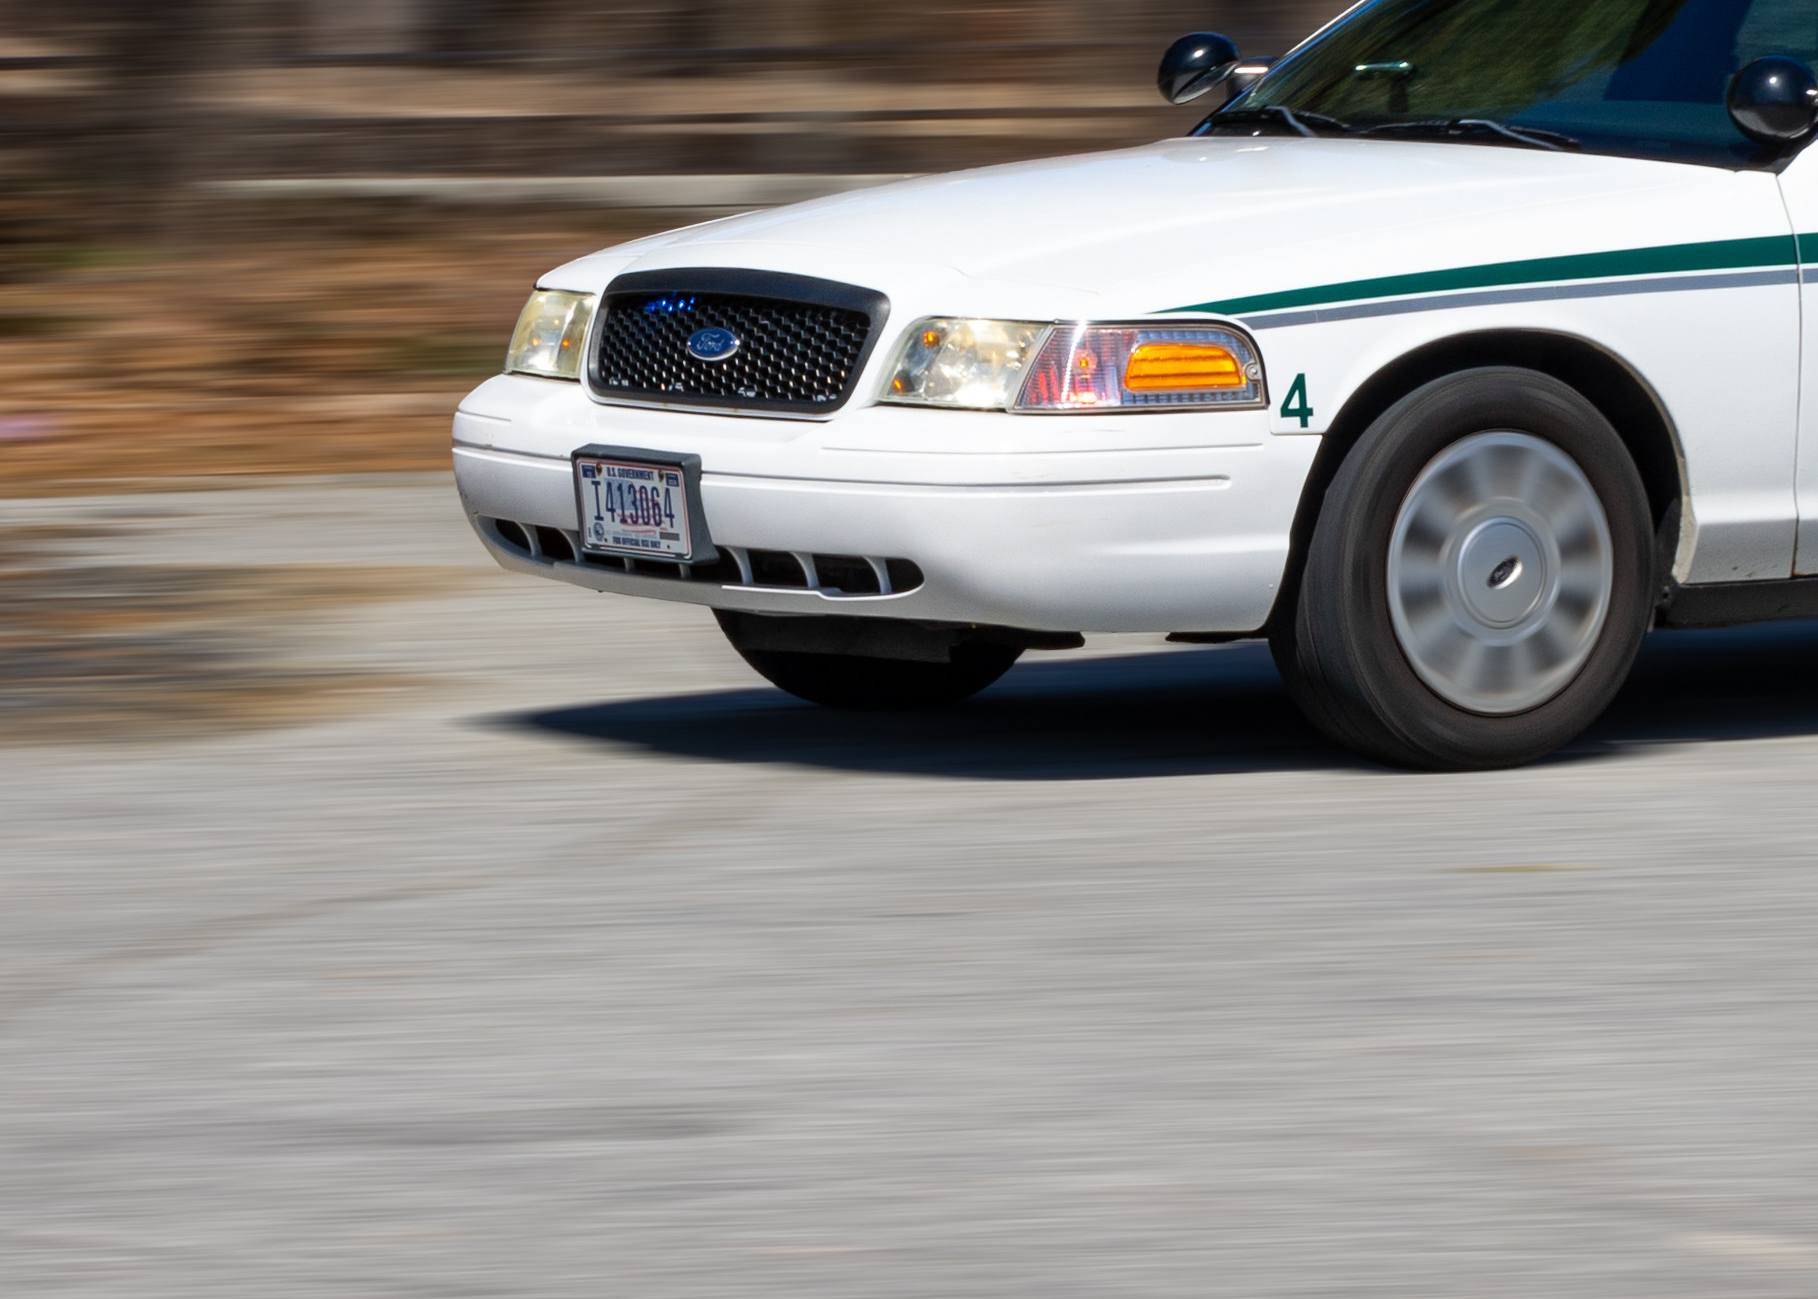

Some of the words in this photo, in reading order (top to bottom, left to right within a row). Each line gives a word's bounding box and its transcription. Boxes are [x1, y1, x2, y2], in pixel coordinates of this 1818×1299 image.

[696, 332, 726, 352] Ford
[1280, 373, 1314, 428] 4
[618, 467, 654, 481] GOVERNMENT
[591, 480, 675, 529] I413064
